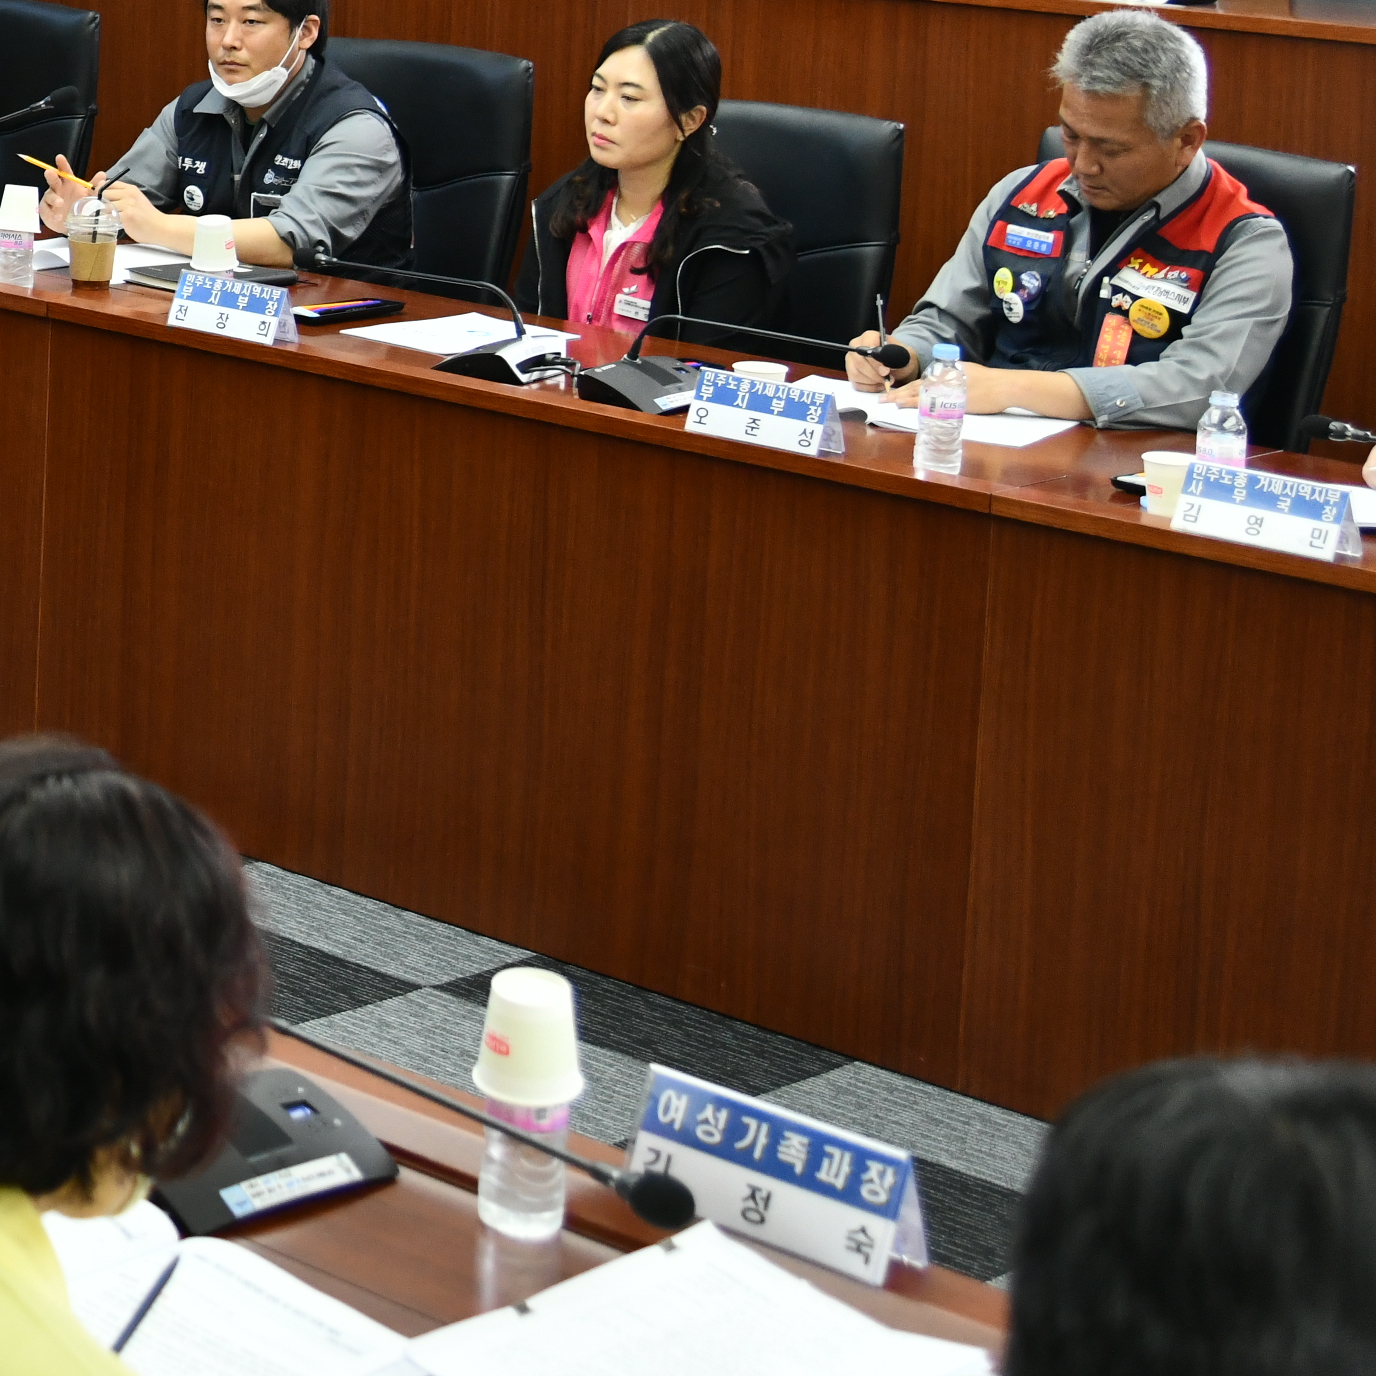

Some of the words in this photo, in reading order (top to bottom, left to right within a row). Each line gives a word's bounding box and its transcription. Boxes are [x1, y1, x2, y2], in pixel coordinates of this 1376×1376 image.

[1192, 463, 1248, 489] 민주노총
[1254, 474, 1342, 505] 거제지역지부
[656, 1087, 897, 1207] 여성가족과장
